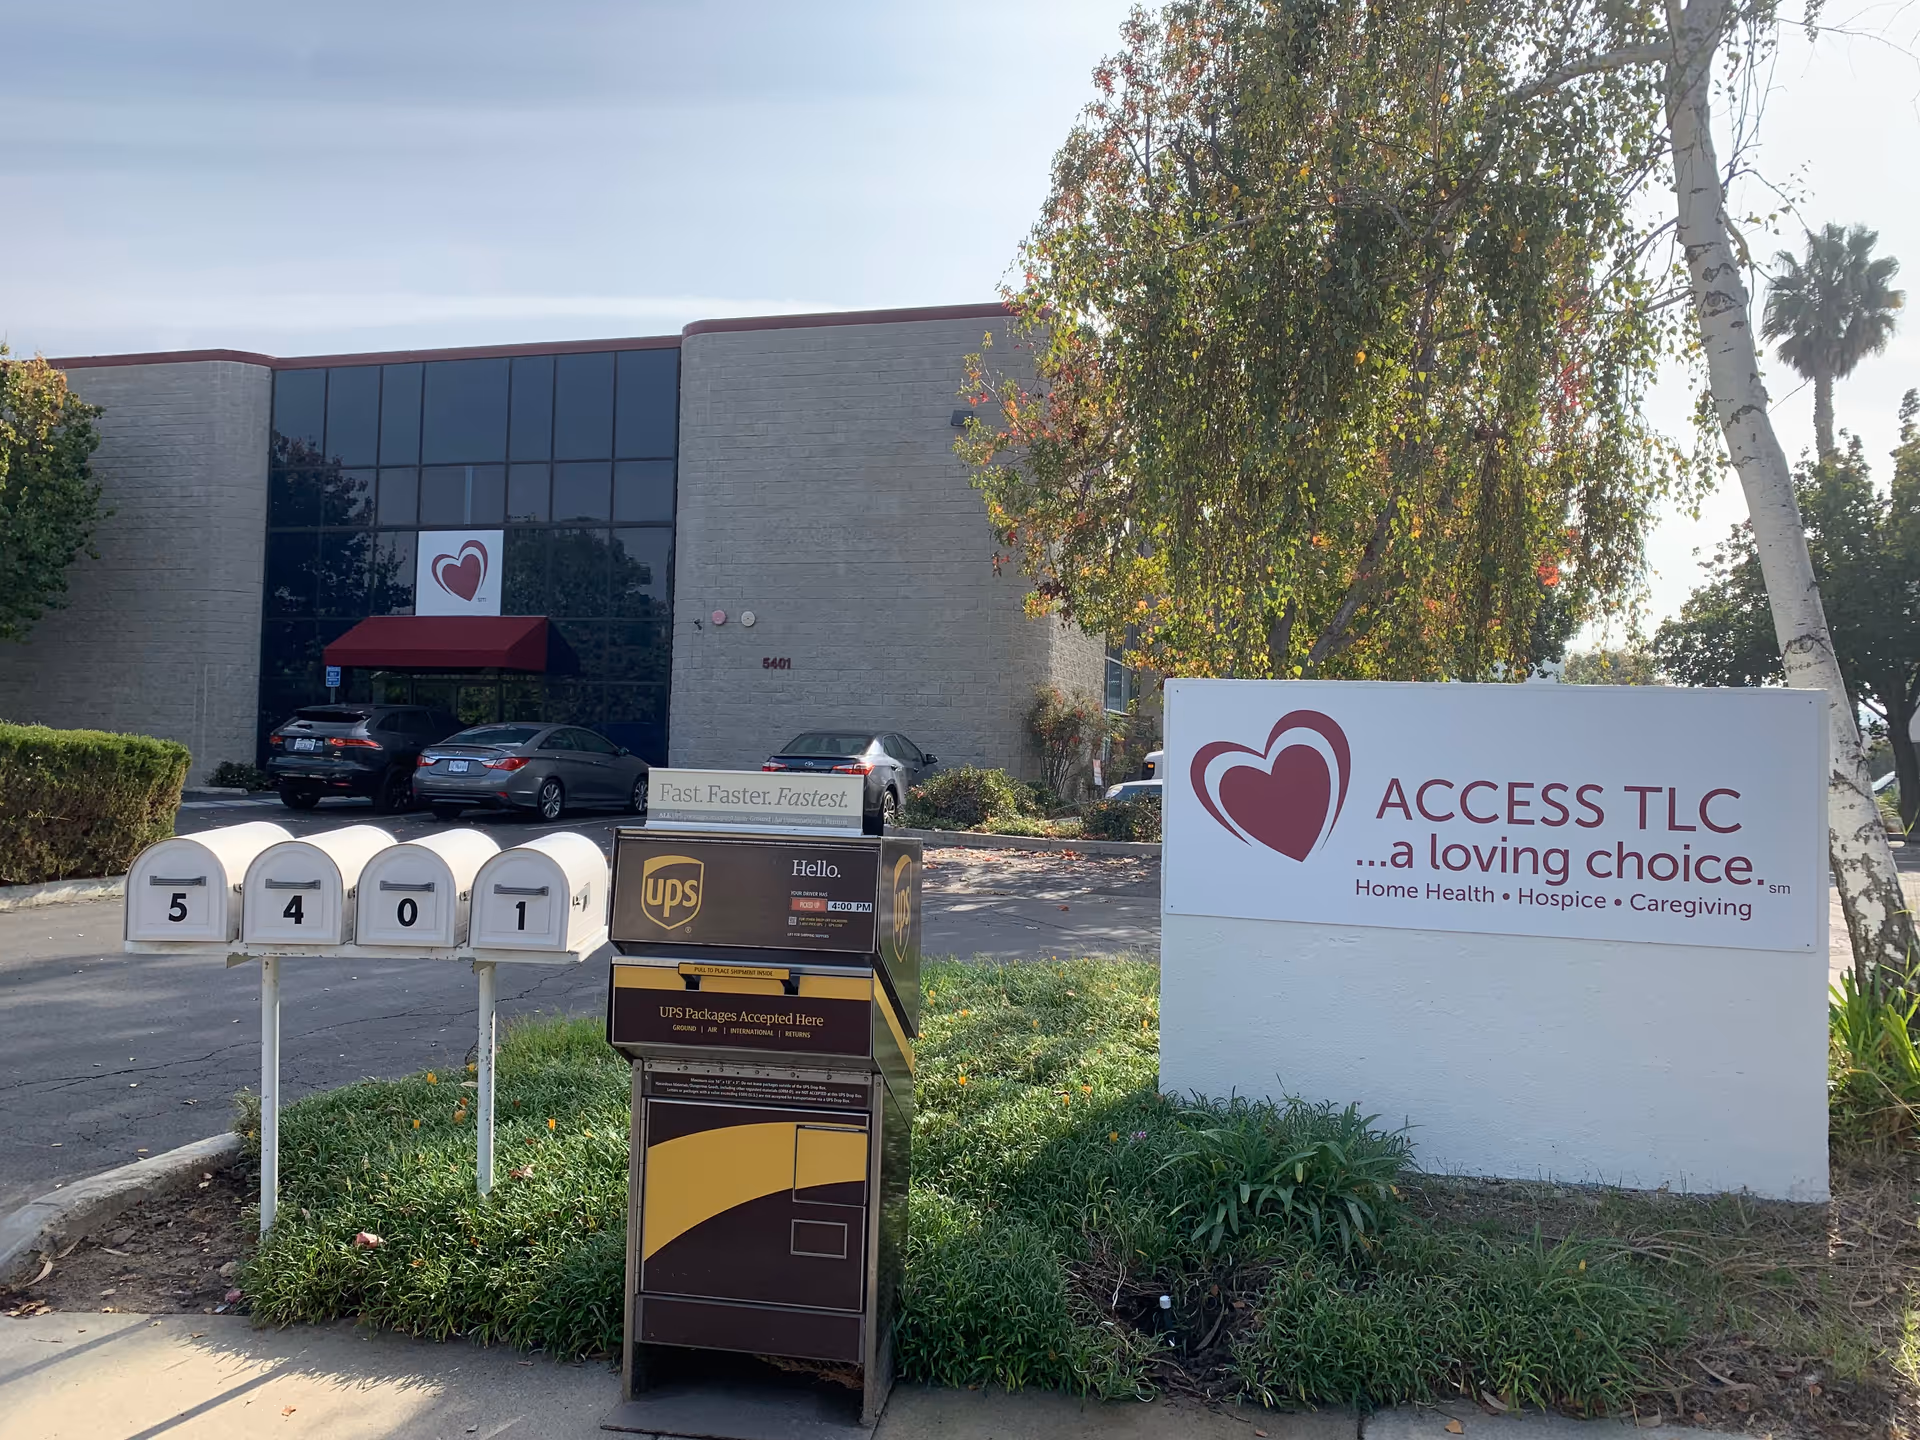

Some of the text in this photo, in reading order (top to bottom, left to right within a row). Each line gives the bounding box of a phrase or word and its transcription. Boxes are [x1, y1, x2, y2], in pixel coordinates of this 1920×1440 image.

[762, 656, 792, 670] 5401
[659, 783, 849, 809] Fast. Faster. Fastest.
[1375, 777, 1743, 834] ACCESS TLC
[791, 859, 841, 878] Hello.
[1430, 832, 1570, 887] loving
[1585, 840, 1765, 886] choice.
[1768, 884, 1791, 895] sm
[831, 902, 871, 911] 4:00 PM
[1355, 878, 1752, 922] Home Health Hospice Caregiving
[168, 893, 527, 931] 5 4 0 1
[730, 968, 756, 976] SHIPMENT
[659, 1006, 824, 1027] UPS Packages Accepted Here
[672, 1024, 697, 1032] GROUND
[730, 1027, 774, 1036] INTERNATIONAL
[785, 1030, 811, 1038] RETURNS
